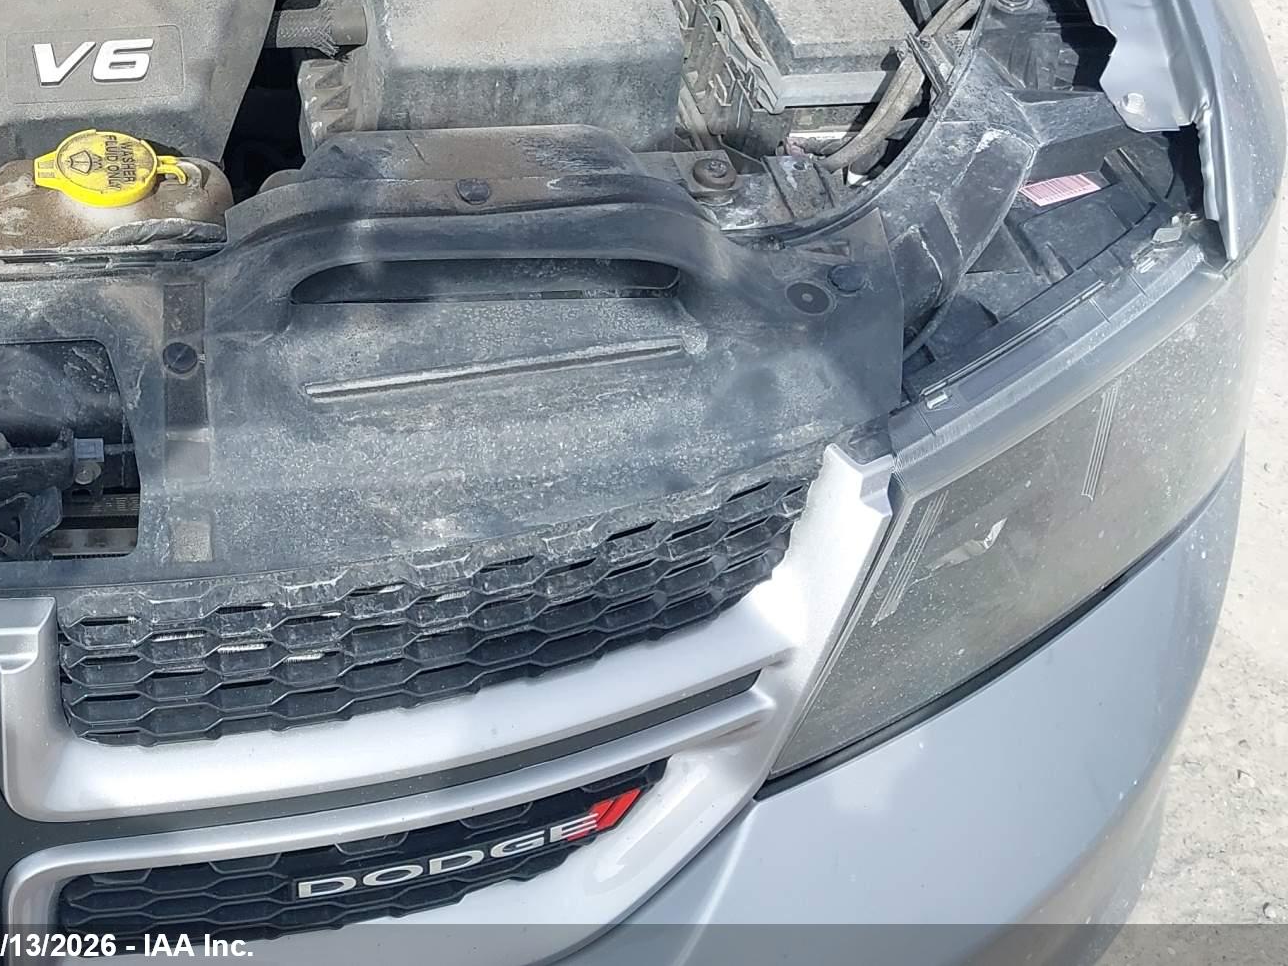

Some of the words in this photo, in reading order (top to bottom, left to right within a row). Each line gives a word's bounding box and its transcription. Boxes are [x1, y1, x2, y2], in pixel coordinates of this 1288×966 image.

[32, 37, 155, 87] V6
[104, 134, 119, 163] FLUID
[120, 140, 137, 185] WASHER
[107, 163, 122, 191] ONLY
[296, 811, 600, 900] DODGE
